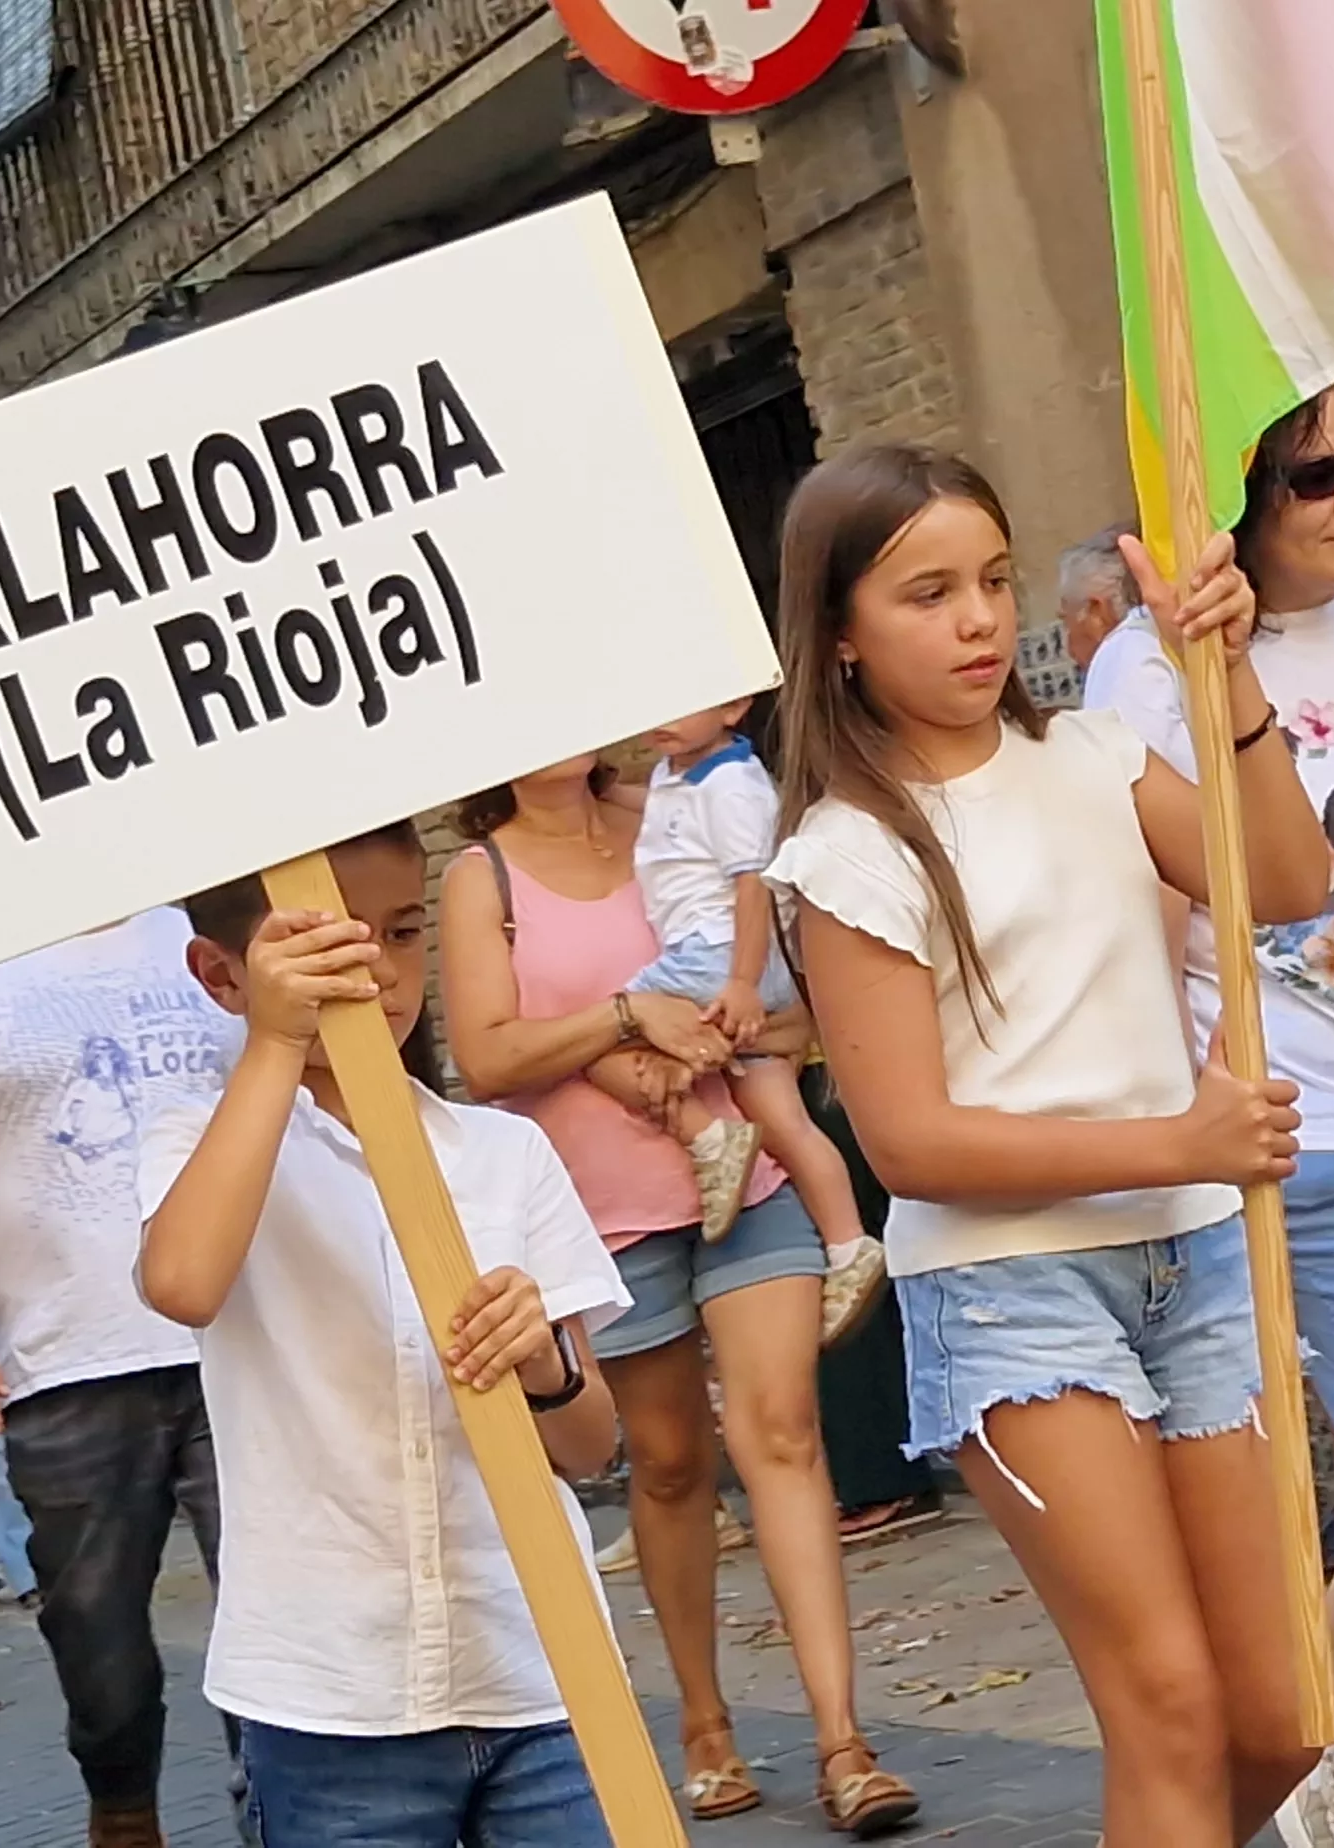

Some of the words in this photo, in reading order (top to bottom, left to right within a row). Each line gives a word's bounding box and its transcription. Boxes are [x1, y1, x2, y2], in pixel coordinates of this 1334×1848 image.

[153, 531, 481, 746] Rioja)
[137, 1031, 218, 1051] PUTA
[141, 1049, 223, 1078] LOCA
